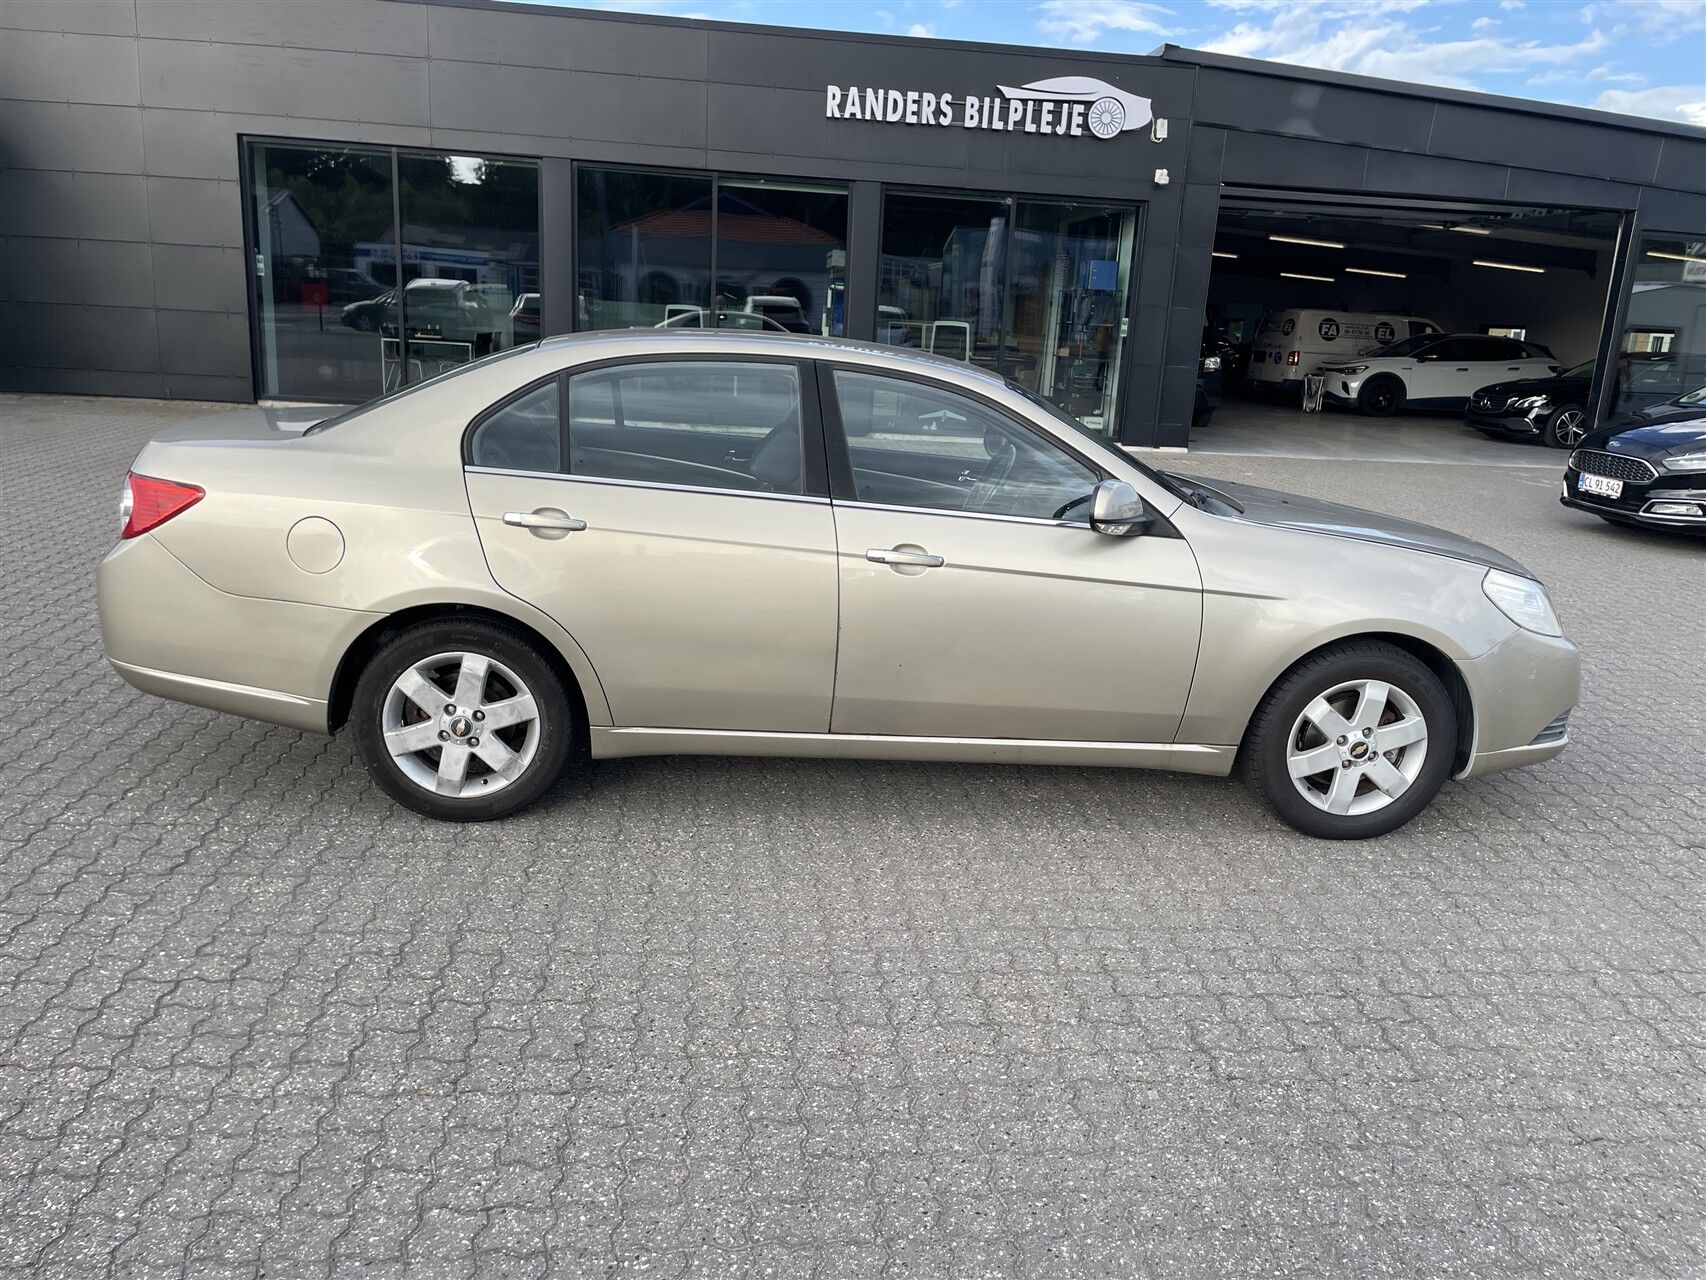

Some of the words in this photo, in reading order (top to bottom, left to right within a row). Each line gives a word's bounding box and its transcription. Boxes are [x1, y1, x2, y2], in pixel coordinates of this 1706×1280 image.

[826, 85, 952, 127] RANDERS
[964, 96, 1085, 136] BILPLEJE
[1321, 324, 1337, 336] FA
[1378, 328, 1392, 339] EL
[1584, 477, 1592, 488] CL
[1595, 479, 1603, 490] 91
[1605, 481, 1620, 493] 542
